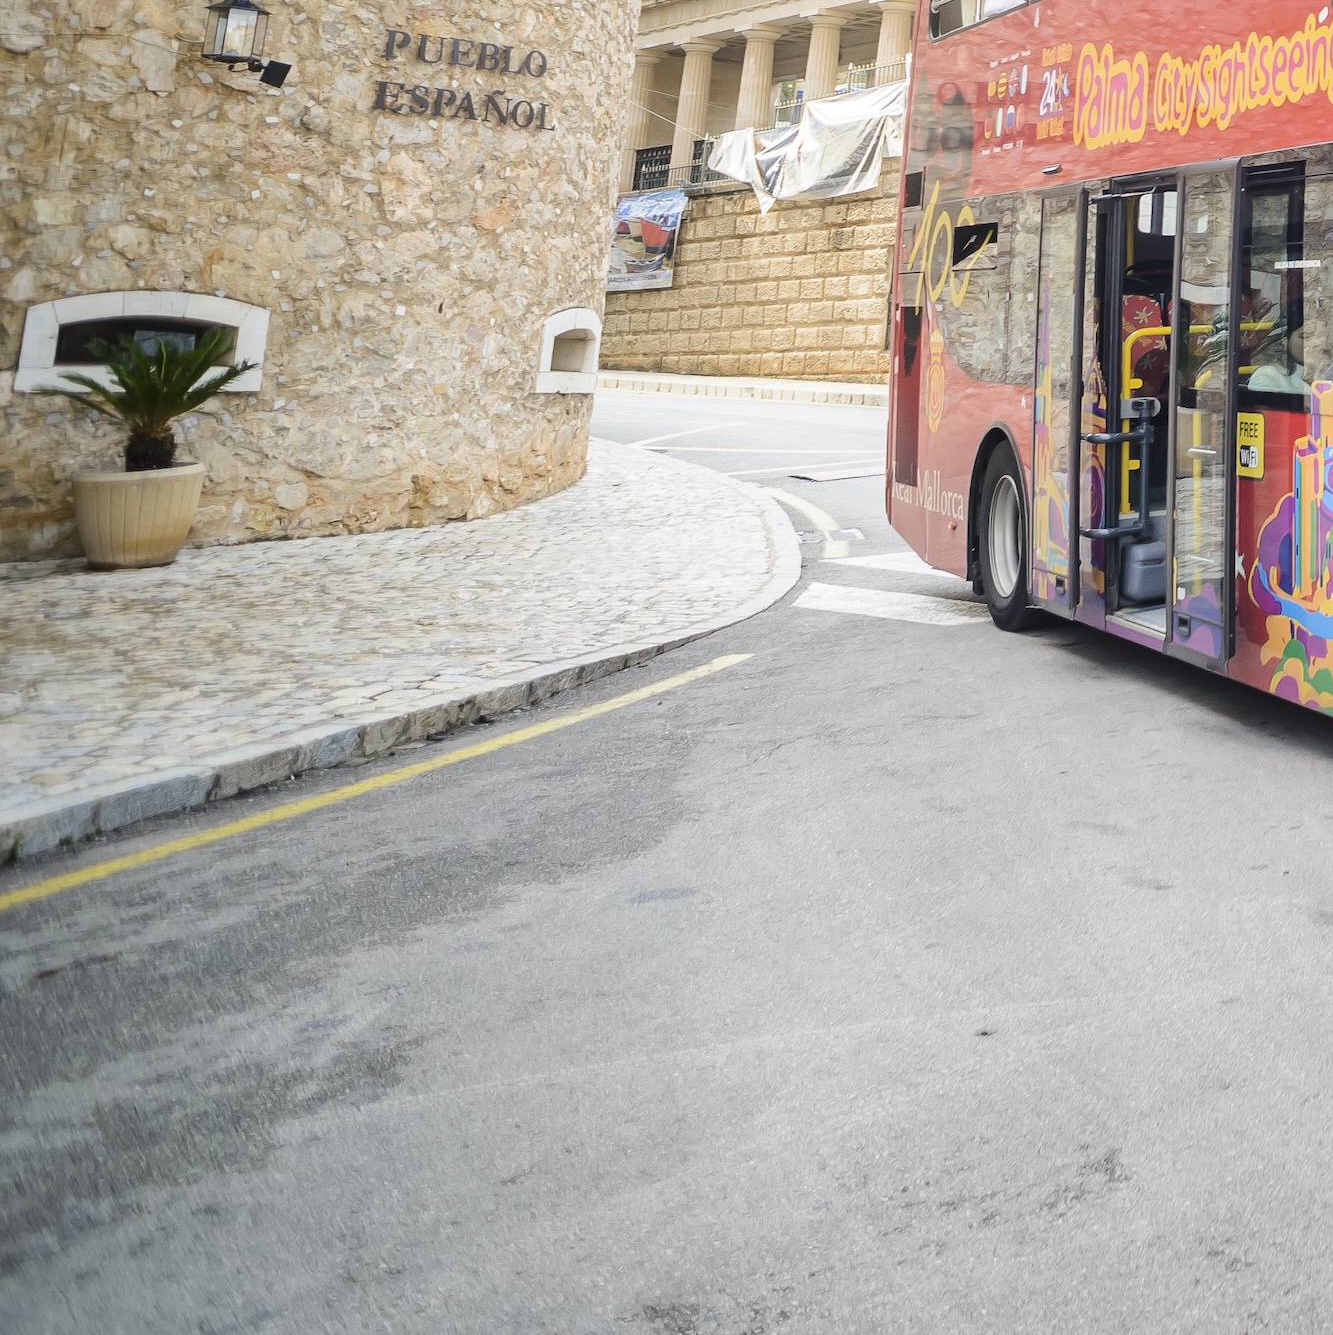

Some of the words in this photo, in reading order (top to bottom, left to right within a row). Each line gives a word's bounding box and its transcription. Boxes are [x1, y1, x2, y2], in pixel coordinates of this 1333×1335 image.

[380, 29, 549, 79] PUEBLO
[371, 80, 557, 132] ESPAÑOL
[1073, 42, 1149, 151] Palma
[1240, 421, 1259, 438] FREE
[915, 468, 964, 520] Mallorca
